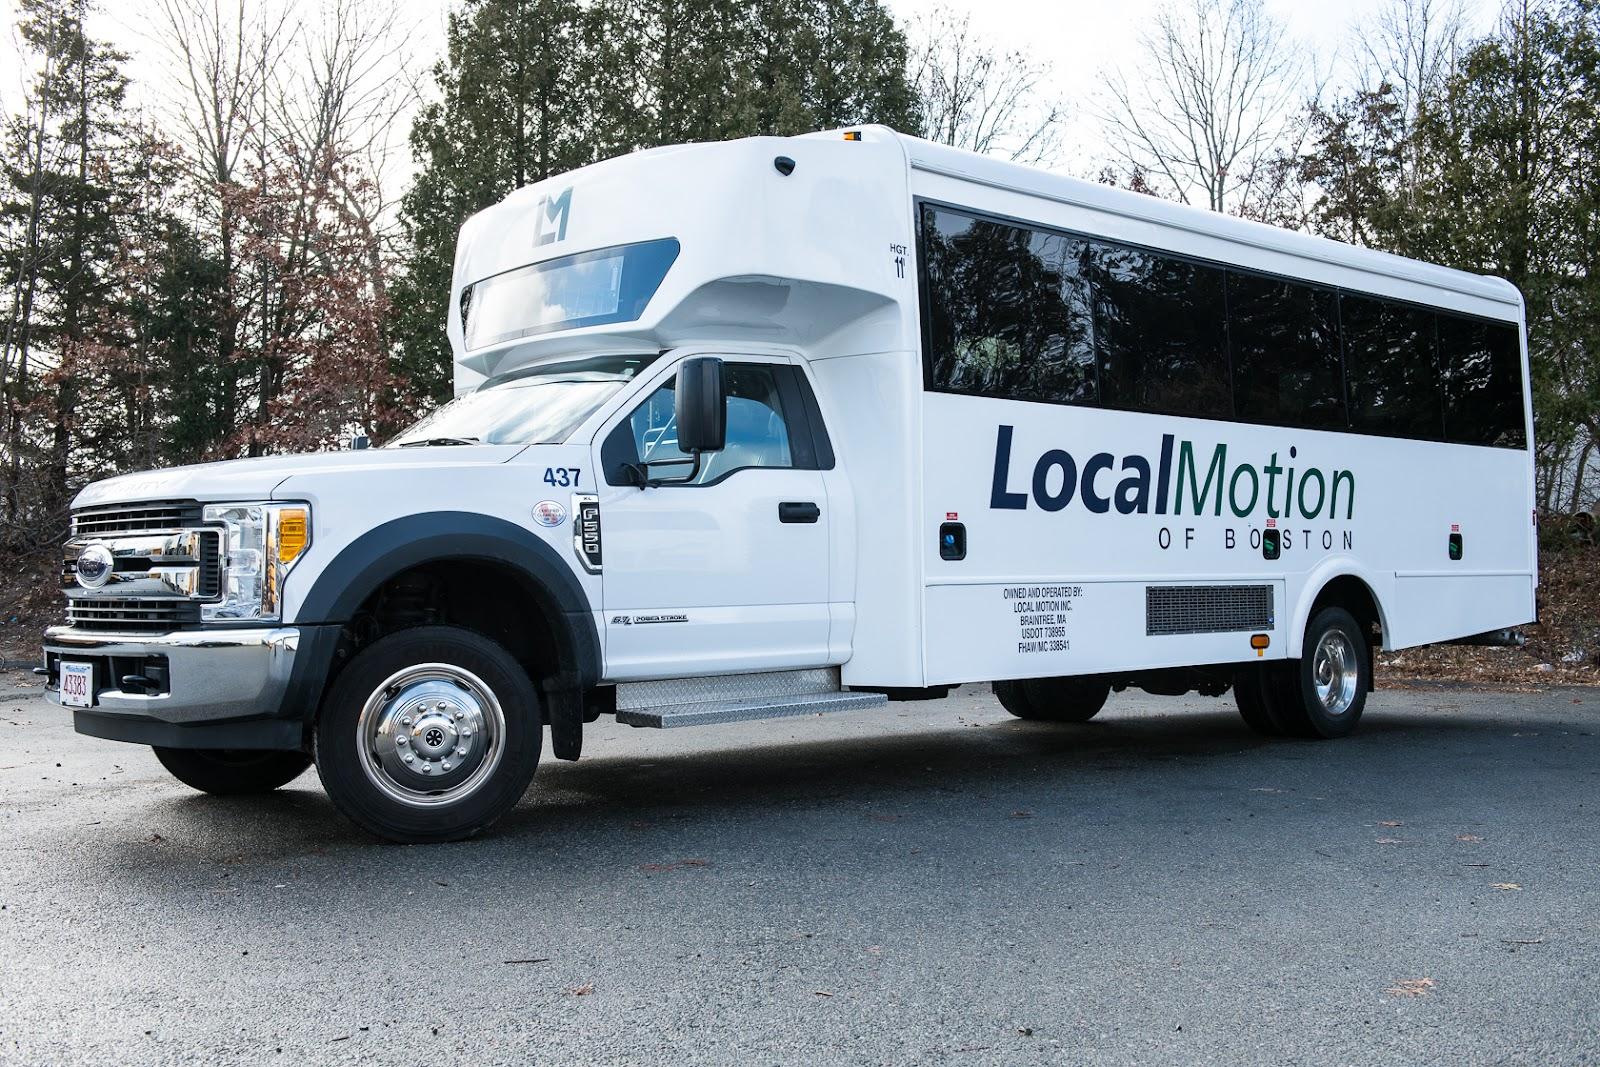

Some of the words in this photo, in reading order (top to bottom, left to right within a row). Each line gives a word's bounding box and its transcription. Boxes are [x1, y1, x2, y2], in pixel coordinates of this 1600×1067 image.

[543, 467, 581, 487] 437
[990, 424, 1355, 519] LocalMotion
[1158, 527, 1195, 550] OF
[1225, 528, 1353, 550] BOSTON
[1003, 588, 1026, 599] OWNED
[1028, 588, 1040, 598] AND
[1041, 586, 1072, 598] OPERATED
[1073, 586, 1083, 597] BY:
[1013, 602, 1035, 613] LOCAL
[1036, 601, 1060, 612] MOTION
[1057, 614, 1067, 624] MA
[1021, 627, 1043, 639] USDOT
[64, 674, 87, 696] 43383
